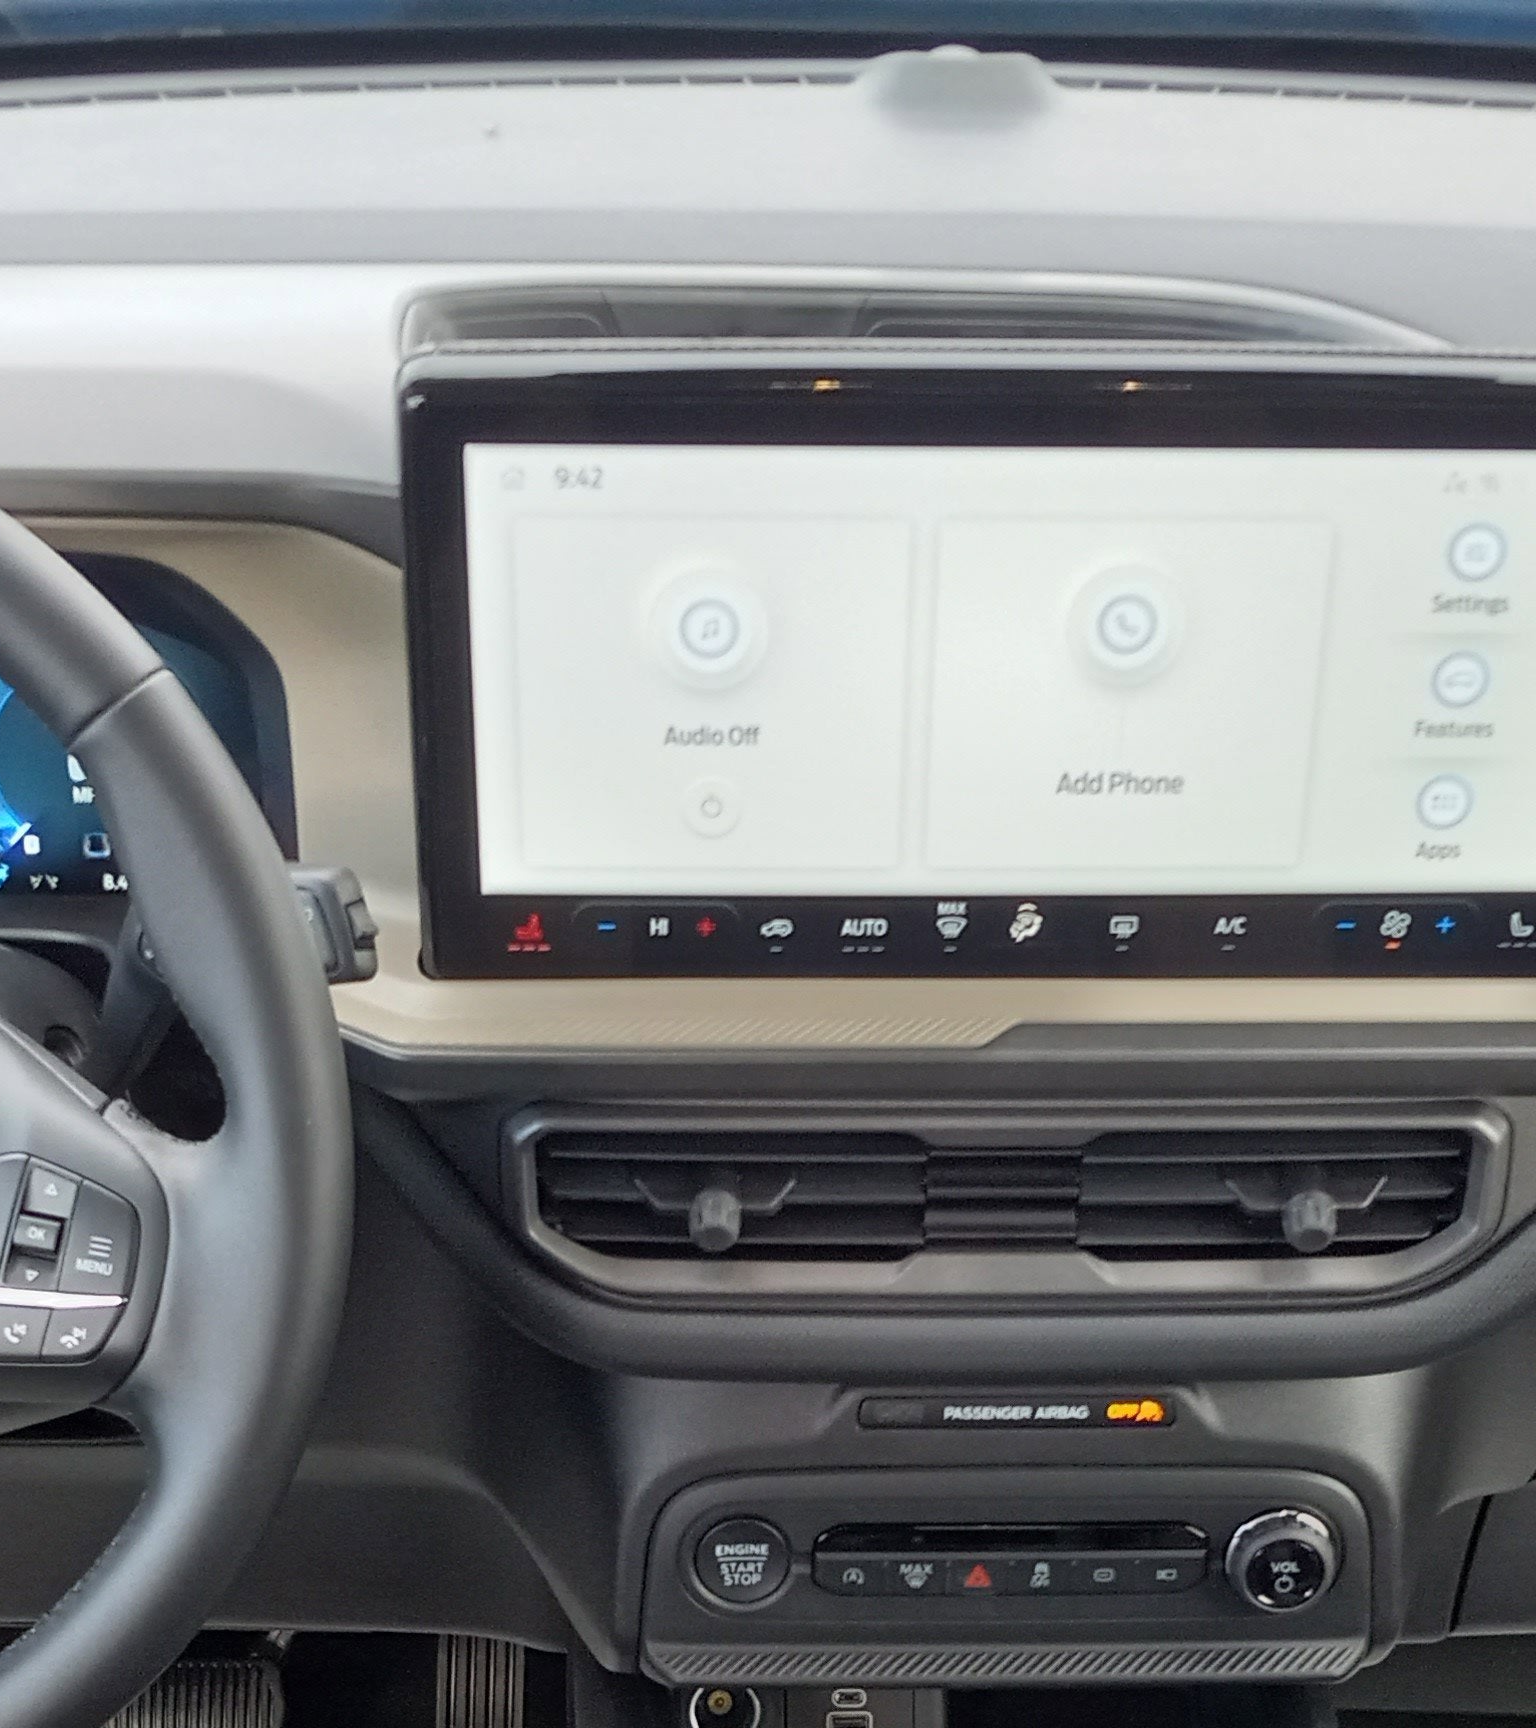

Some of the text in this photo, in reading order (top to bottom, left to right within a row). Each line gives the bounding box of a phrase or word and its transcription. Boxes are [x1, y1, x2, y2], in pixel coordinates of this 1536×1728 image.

[553, 466, 605, 491] 9:42
[1431, 593, 1510, 616] Settings
[664, 725, 760, 747] Audio Off
[1414, 718, 1495, 739] Features
[1055, 771, 1185, 795] Add Phone
[937, 901, 968, 915] MAX
[649, 918, 670, 937] HI
[841, 918, 889, 938] AUTO
[1213, 915, 1248, 936] A/C
[26, 1225, 46, 1241] OK
[75, 1257, 113, 1277] MENU
[943, 1405, 1033, 1420] PASSENGER
[1034, 1405, 1090, 1420] AIRBAG
[715, 1543, 769, 1557] ENGINE
[720, 1561, 765, 1574] START
[898, 1562, 934, 1575] MAX
[1270, 1560, 1301, 1574] VOL
[723, 1573, 762, 1586] STOP
